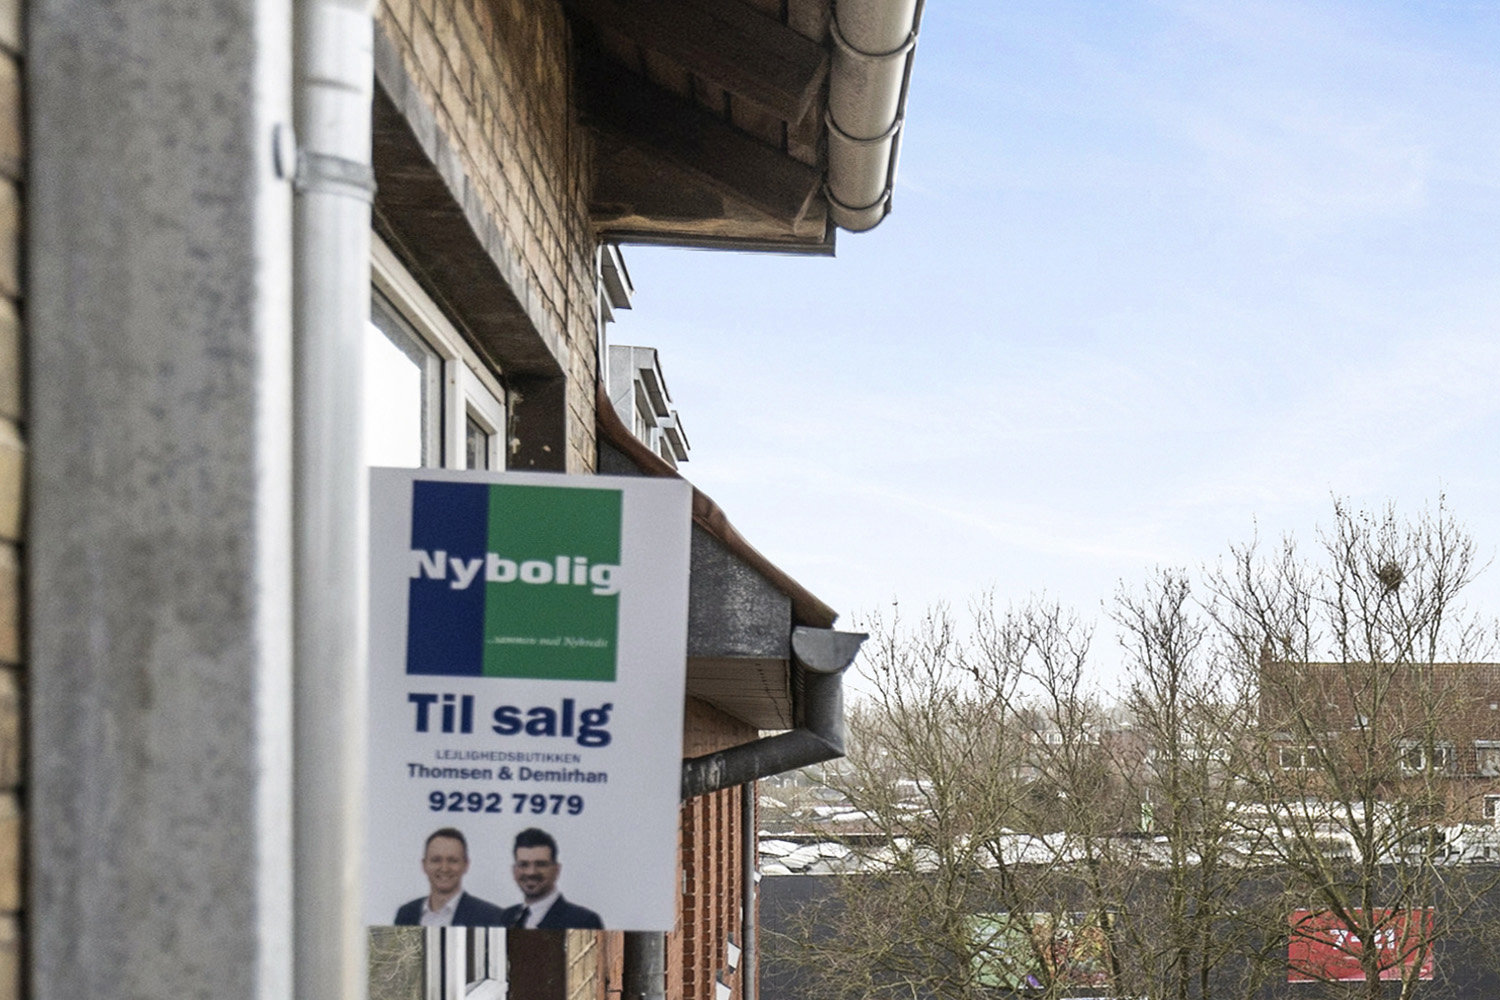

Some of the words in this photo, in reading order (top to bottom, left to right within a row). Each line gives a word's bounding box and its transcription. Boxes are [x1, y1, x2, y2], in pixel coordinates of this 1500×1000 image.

[409, 549, 622, 596] Nybolig
[408, 692, 475, 734] Til
[492, 698, 614, 748] salg
[435, 750, 581, 764] LEJLIGHEDSBUTIKKEN
[407, 763, 493, 780] Thomsen
[498, 766, 513, 781] &
[519, 766, 608, 783] Demirhan
[428, 791, 503, 813] 9292
[511, 793, 585, 815] 7979
